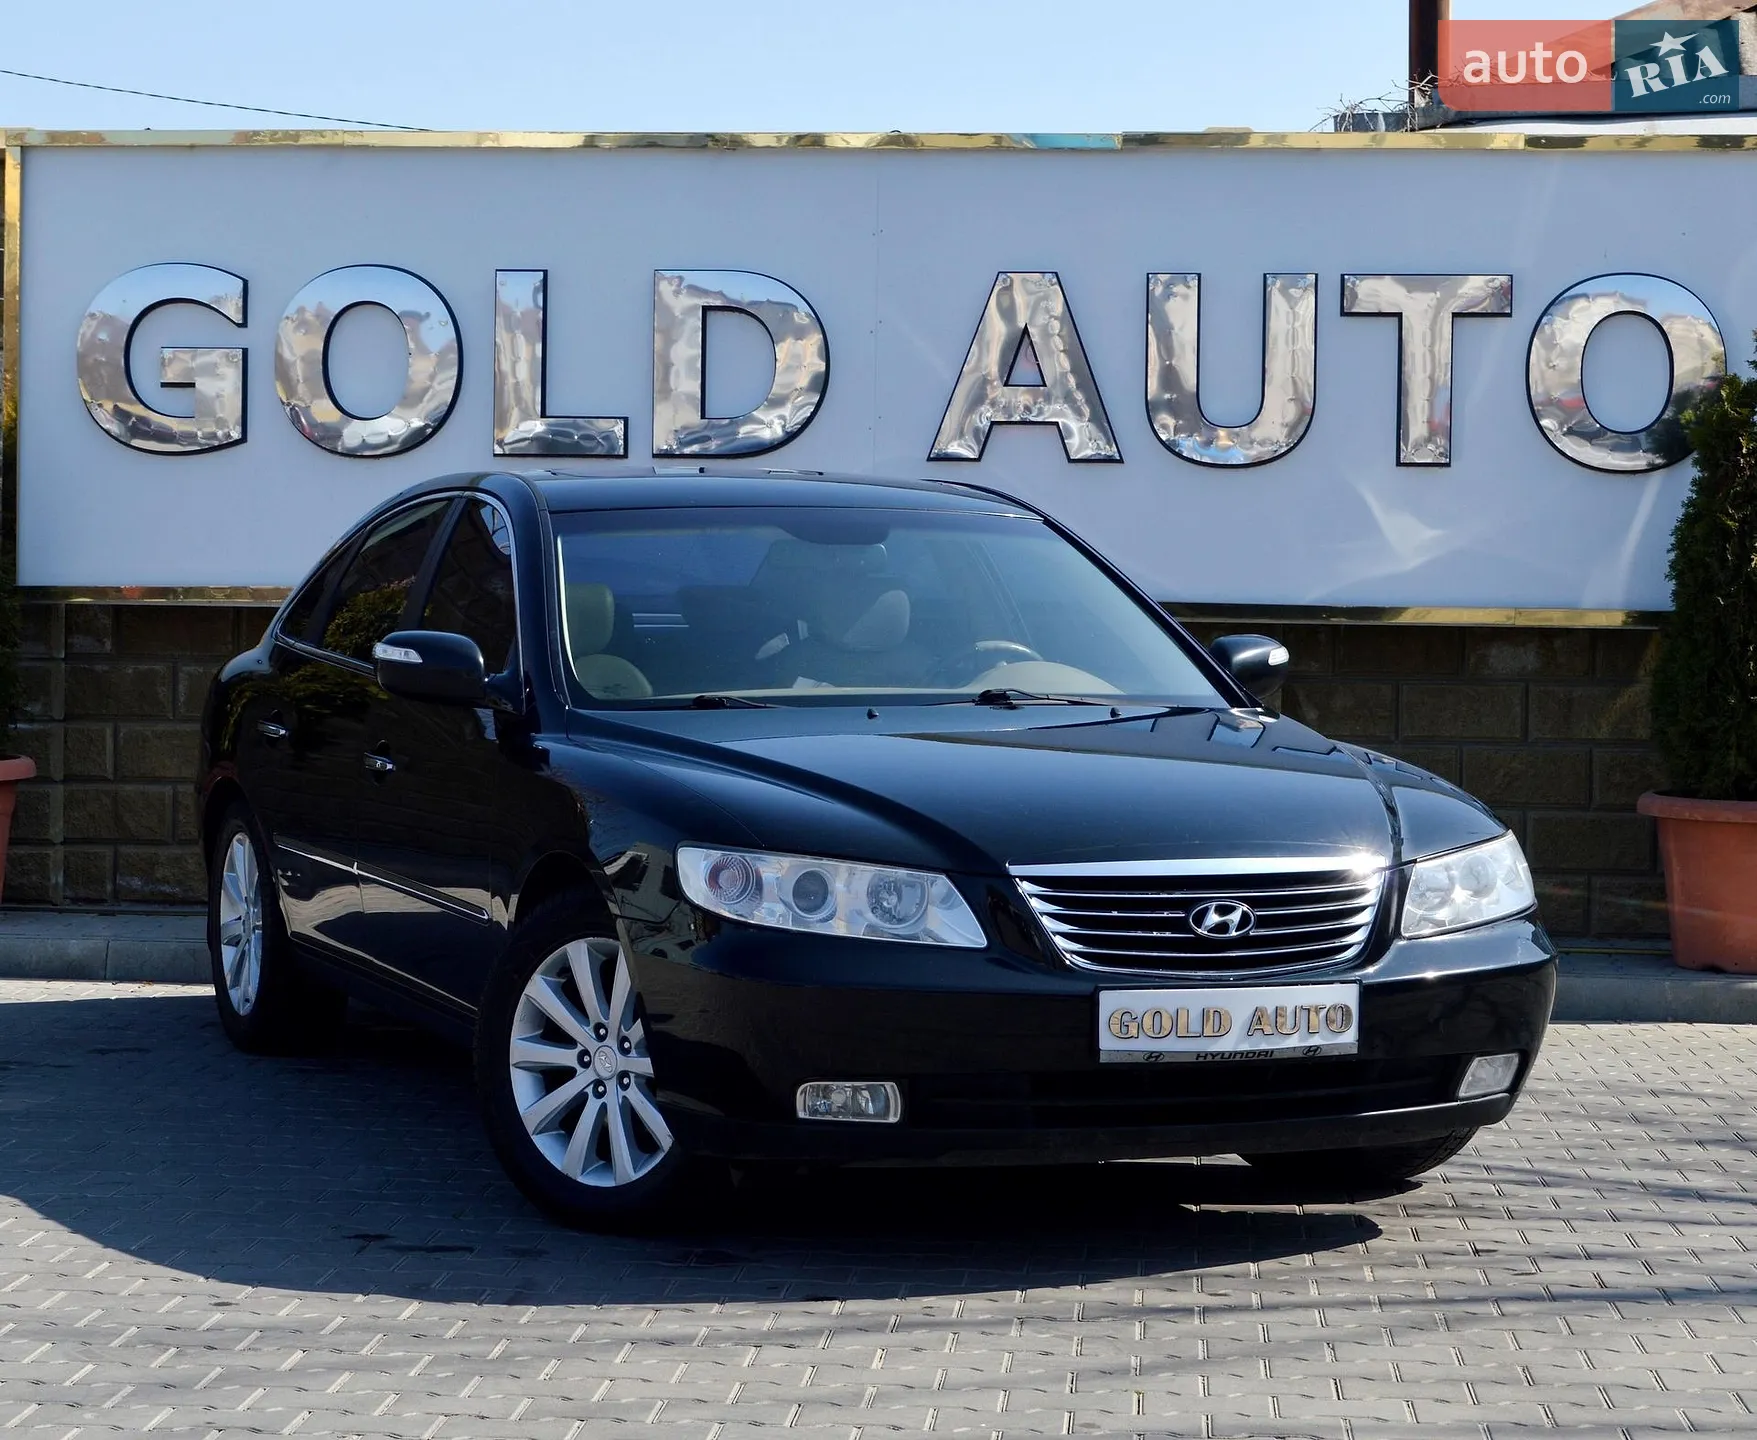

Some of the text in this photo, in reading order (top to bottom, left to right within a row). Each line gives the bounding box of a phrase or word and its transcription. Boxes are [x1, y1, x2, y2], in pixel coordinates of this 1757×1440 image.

[77, 262, 1727, 475] GOLD AUTO
[1108, 1003, 1354, 1039] GOLD AUTO
[1196, 1049, 1275, 1061] HYUNDAI
